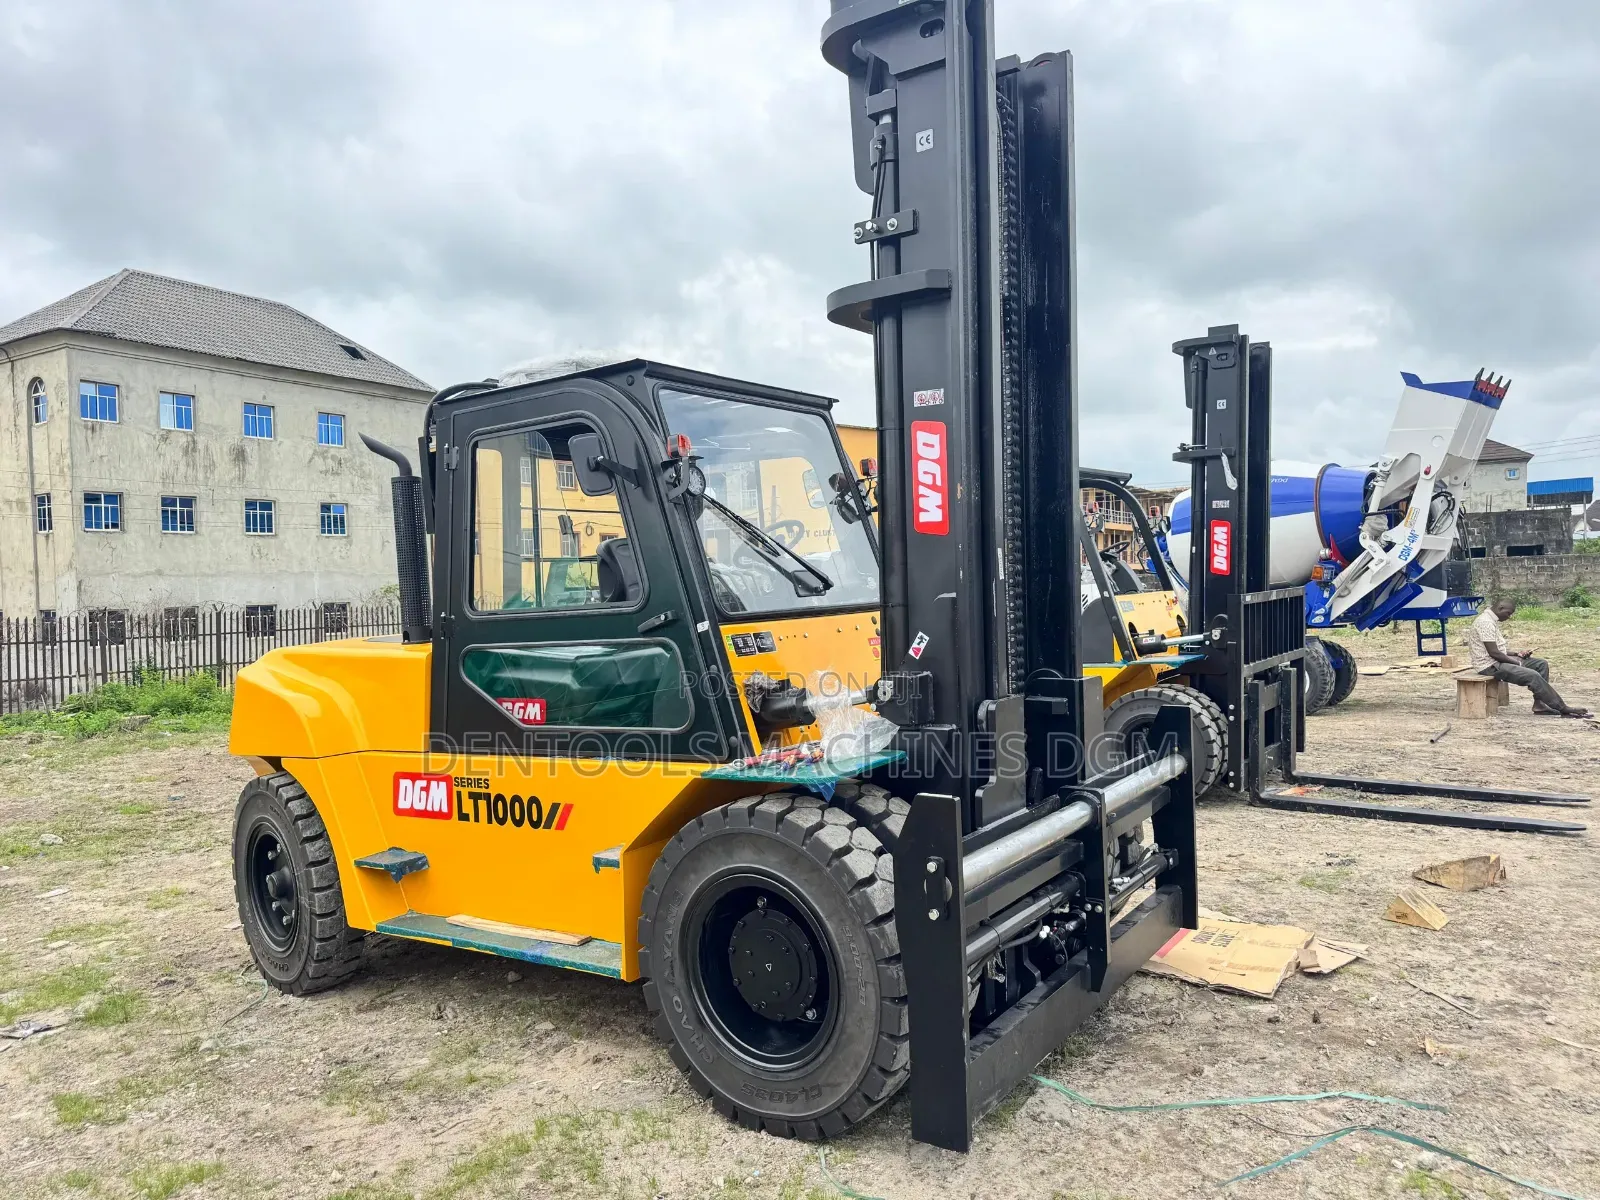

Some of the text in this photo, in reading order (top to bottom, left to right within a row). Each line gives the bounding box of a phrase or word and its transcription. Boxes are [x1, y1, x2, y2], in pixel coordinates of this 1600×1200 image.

[916, 430, 943, 523] DGM
[1213, 526, 1228, 571] DGM
[397, 778, 449, 813] DGM
[453, 776, 490, 790] SERIES
[456, 790, 543, 830] LT1000
